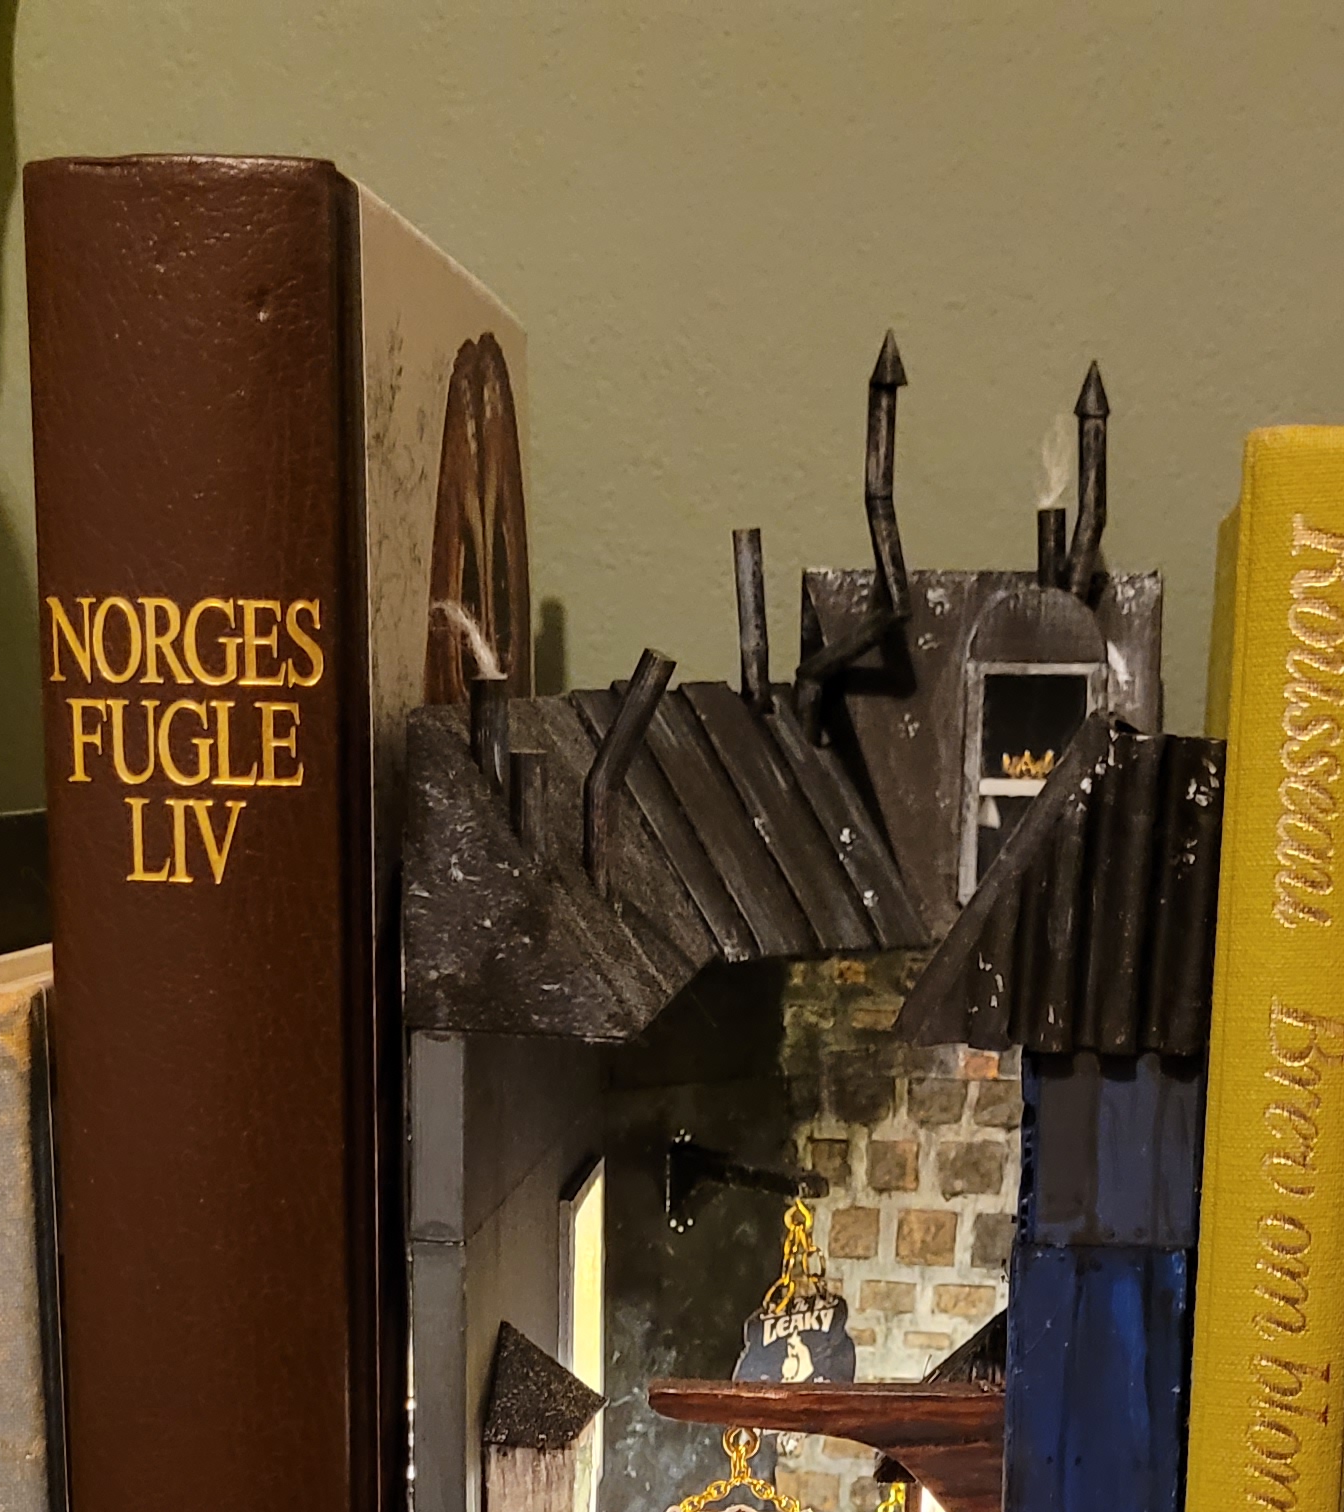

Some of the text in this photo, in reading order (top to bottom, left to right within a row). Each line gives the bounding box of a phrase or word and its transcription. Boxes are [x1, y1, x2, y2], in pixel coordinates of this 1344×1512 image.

[45, 596, 324, 688] NORGES
[65, 697, 304, 786] FUGLE
[123, 797, 247, 885] LIV
[1252, 1212, 1313, 1342] om
[762, 1308, 835, 1347] LEAKY
